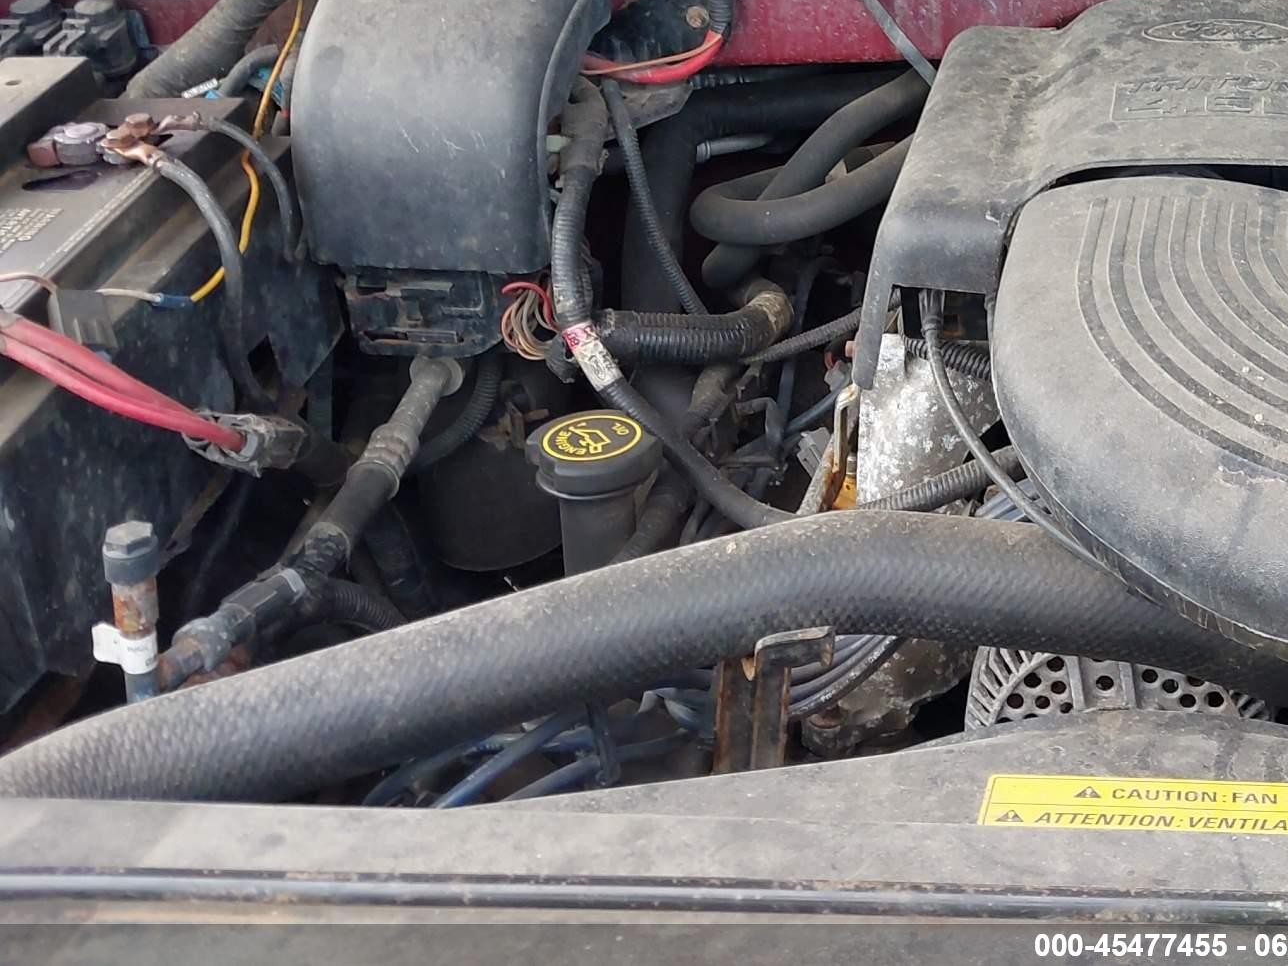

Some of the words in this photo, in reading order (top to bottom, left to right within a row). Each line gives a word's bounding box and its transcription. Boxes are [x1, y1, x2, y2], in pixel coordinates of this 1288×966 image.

[611, 422, 630, 436] OIL
[554, 430, 587, 456] ENGINE
[1231, 791, 1279, 805] FAN
